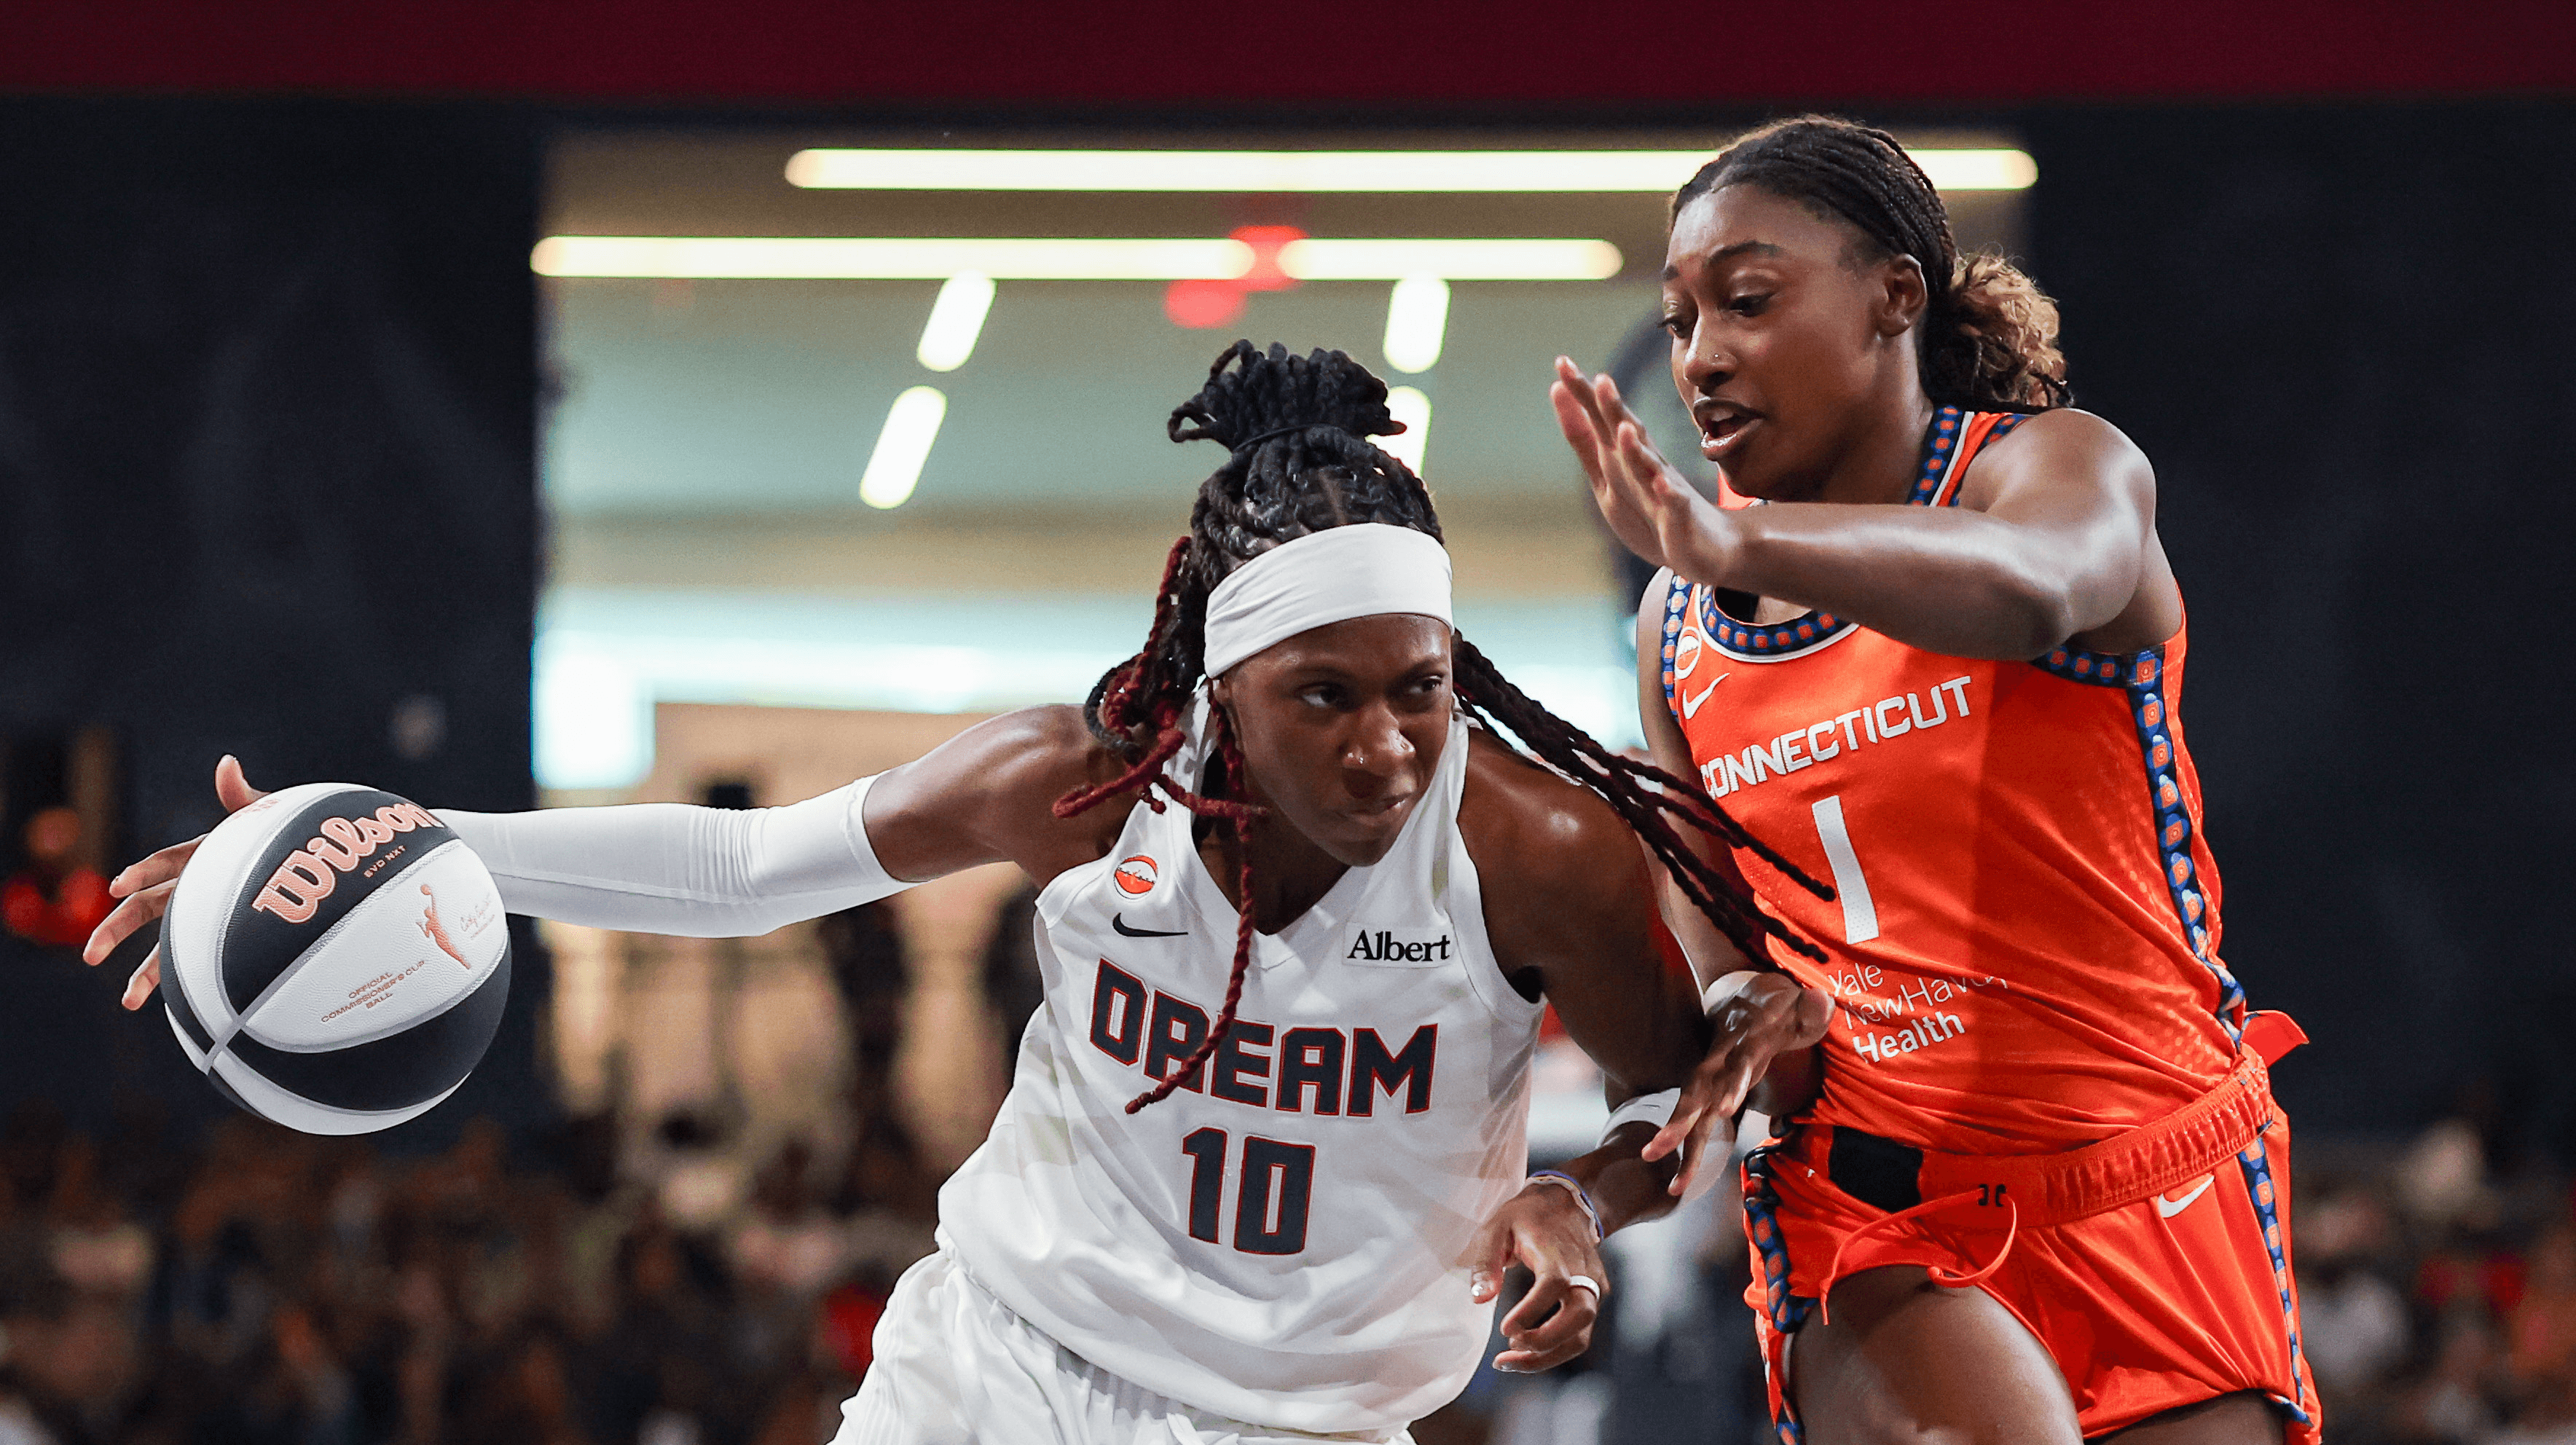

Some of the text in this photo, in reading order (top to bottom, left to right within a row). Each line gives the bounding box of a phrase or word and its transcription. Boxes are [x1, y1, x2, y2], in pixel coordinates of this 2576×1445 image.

[1700, 675, 1971, 800] CONNECTICUT
[251, 802, 445, 924] Wilson
[364, 845, 407, 878] EVO NXT
[1811, 795, 1880, 945] 1
[1346, 929, 1450, 962] Albert
[348, 972, 393, 999] OFFICIAL
[405, 960, 425, 976] CUP
[1828, 962, 1883, 997] Yale
[366, 992, 394, 1009] BALL
[1089, 957, 1439, 1117] DREAM
[1852, 1010, 1966, 1063] Health
[1182, 1126, 1316, 1255] 10
